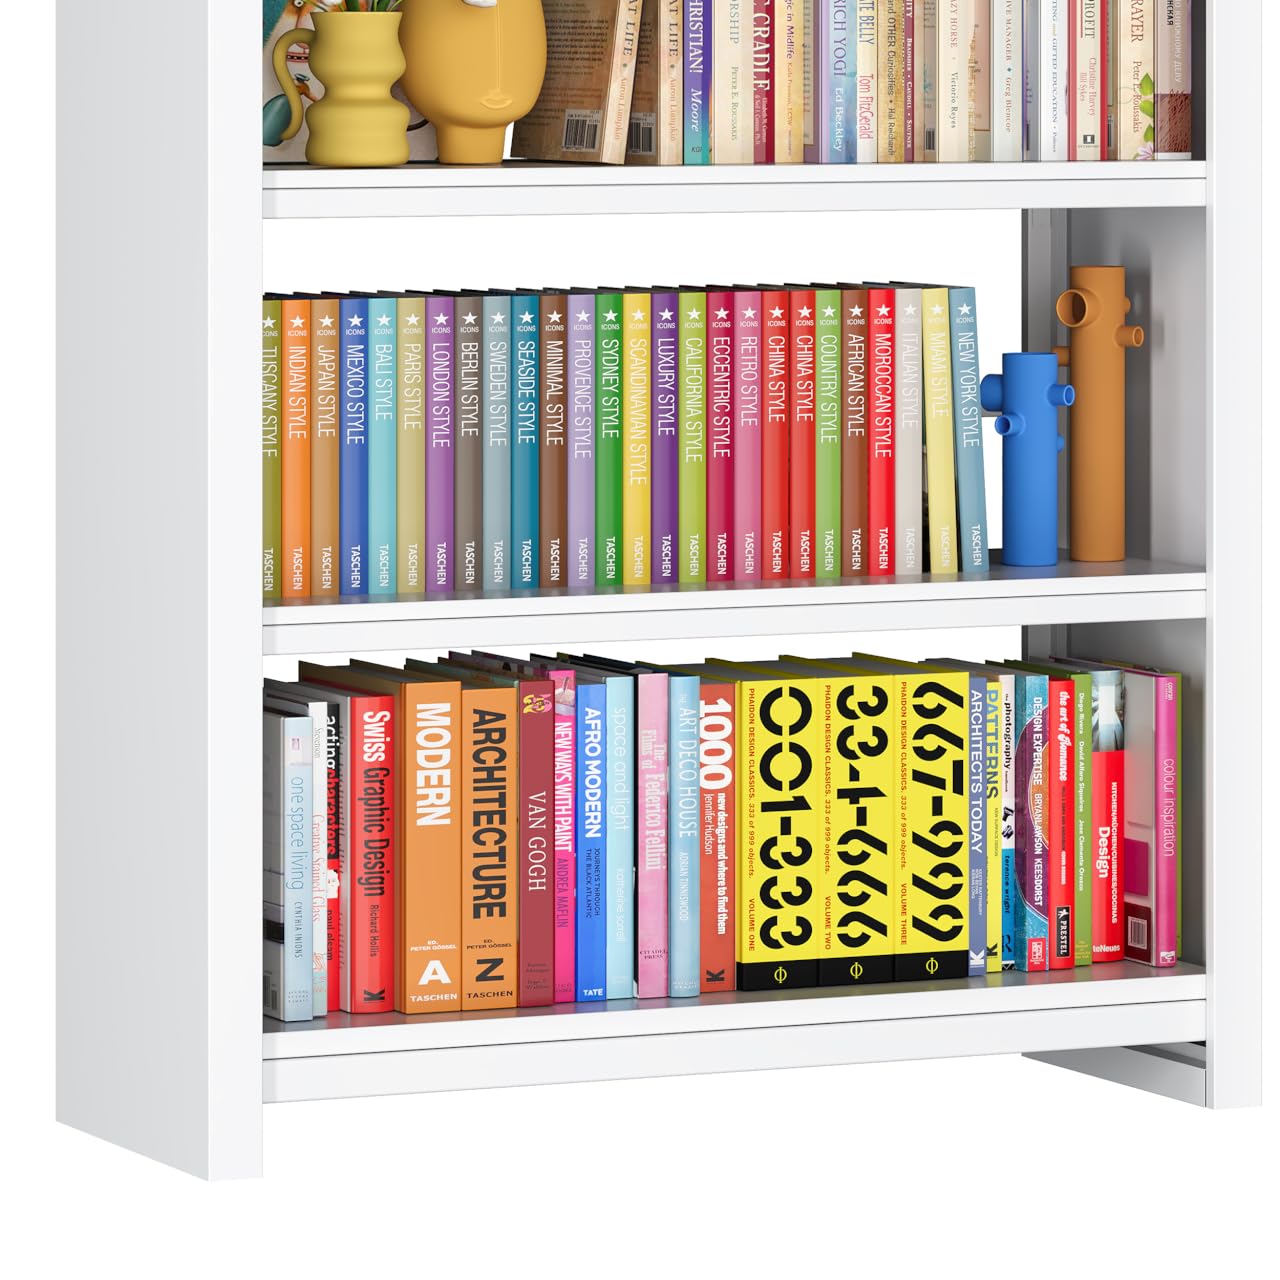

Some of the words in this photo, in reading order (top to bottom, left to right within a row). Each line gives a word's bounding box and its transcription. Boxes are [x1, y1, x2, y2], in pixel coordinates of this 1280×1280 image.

[861, 12, 874, 45] BELLY
[753, 14, 770, 91] CRADLE
[833, 37, 846, 77] YOGI
[691, 88, 702, 132] Moore
[603, 339, 619, 393] SYDNEY
[769, 336, 784, 377] CHINA
[958, 333, 975, 362] NEW
[289, 346, 306, 392] INDIAN
[347, 345, 364, 398] MEXICO
[433, 343, 449, 401] LONDON
[518, 341, 535, 398] SEASIDE
[714, 337, 730, 411] ECCENTRIC
[875, 334, 891, 413] MOROCCAN
[961, 367, 977, 403] YORK
[289, 397, 306, 439] STYLE
[603, 397, 619, 438] STYLE
[769, 381, 784, 422] STYLE
[347, 402, 364, 444] STYLE
[433, 406, 449, 448] STYLE
[518, 403, 535, 444] STYLE
[714, 416, 730, 458] STYLE
[875, 417, 891, 457] STYLE
[962, 407, 979, 448] STYLE
[437, 542, 446, 585] TASCHEN
[879, 527, 888, 569] TASCHEN
[554, 722, 572, 748] NEW
[585, 708, 601, 756] AFRO
[1033, 697, 1042, 733] DESIGN
[363, 711, 391, 762] Swiss
[699, 698, 732, 790] 1000
[971, 690, 983, 794] ARCHITECTS
[986, 690, 998, 799] PATTERNS
[416, 703, 451, 826] MODERN
[554, 749, 572, 782] WAYS
[1033, 734, 1042, 786] EXPERTISE
[1163, 759, 1175, 794] colour
[291, 777, 304, 802] one
[358, 767, 390, 833] Graphic
[528, 792, 546, 829] VAN
[554, 784, 572, 811] WITH
[585, 760, 601, 838] MODERN
[704, 794, 713, 823] Jennifer
[287, 804, 304, 850] space
[473, 708, 506, 919] ARCHITECTURE
[554, 813, 572, 852] PAINT
[760, 687, 812, 949] 001-333
[836, 685, 888, 948] 334-666
[912, 681, 964, 942] 667-999
[971, 798, 983, 853] TODAY
[1163, 798, 1175, 857] inspiration
[705, 824, 713, 855] Hudson
[1096, 826, 1110, 878] Design
[286, 852, 304, 890] living
[358, 838, 390, 897] Design
[528, 835, 546, 891] GOGH
[370, 905, 379, 934] Richard
[370, 936, 379, 957] Hollis
[410, 994, 457, 1002] TASCHEN
